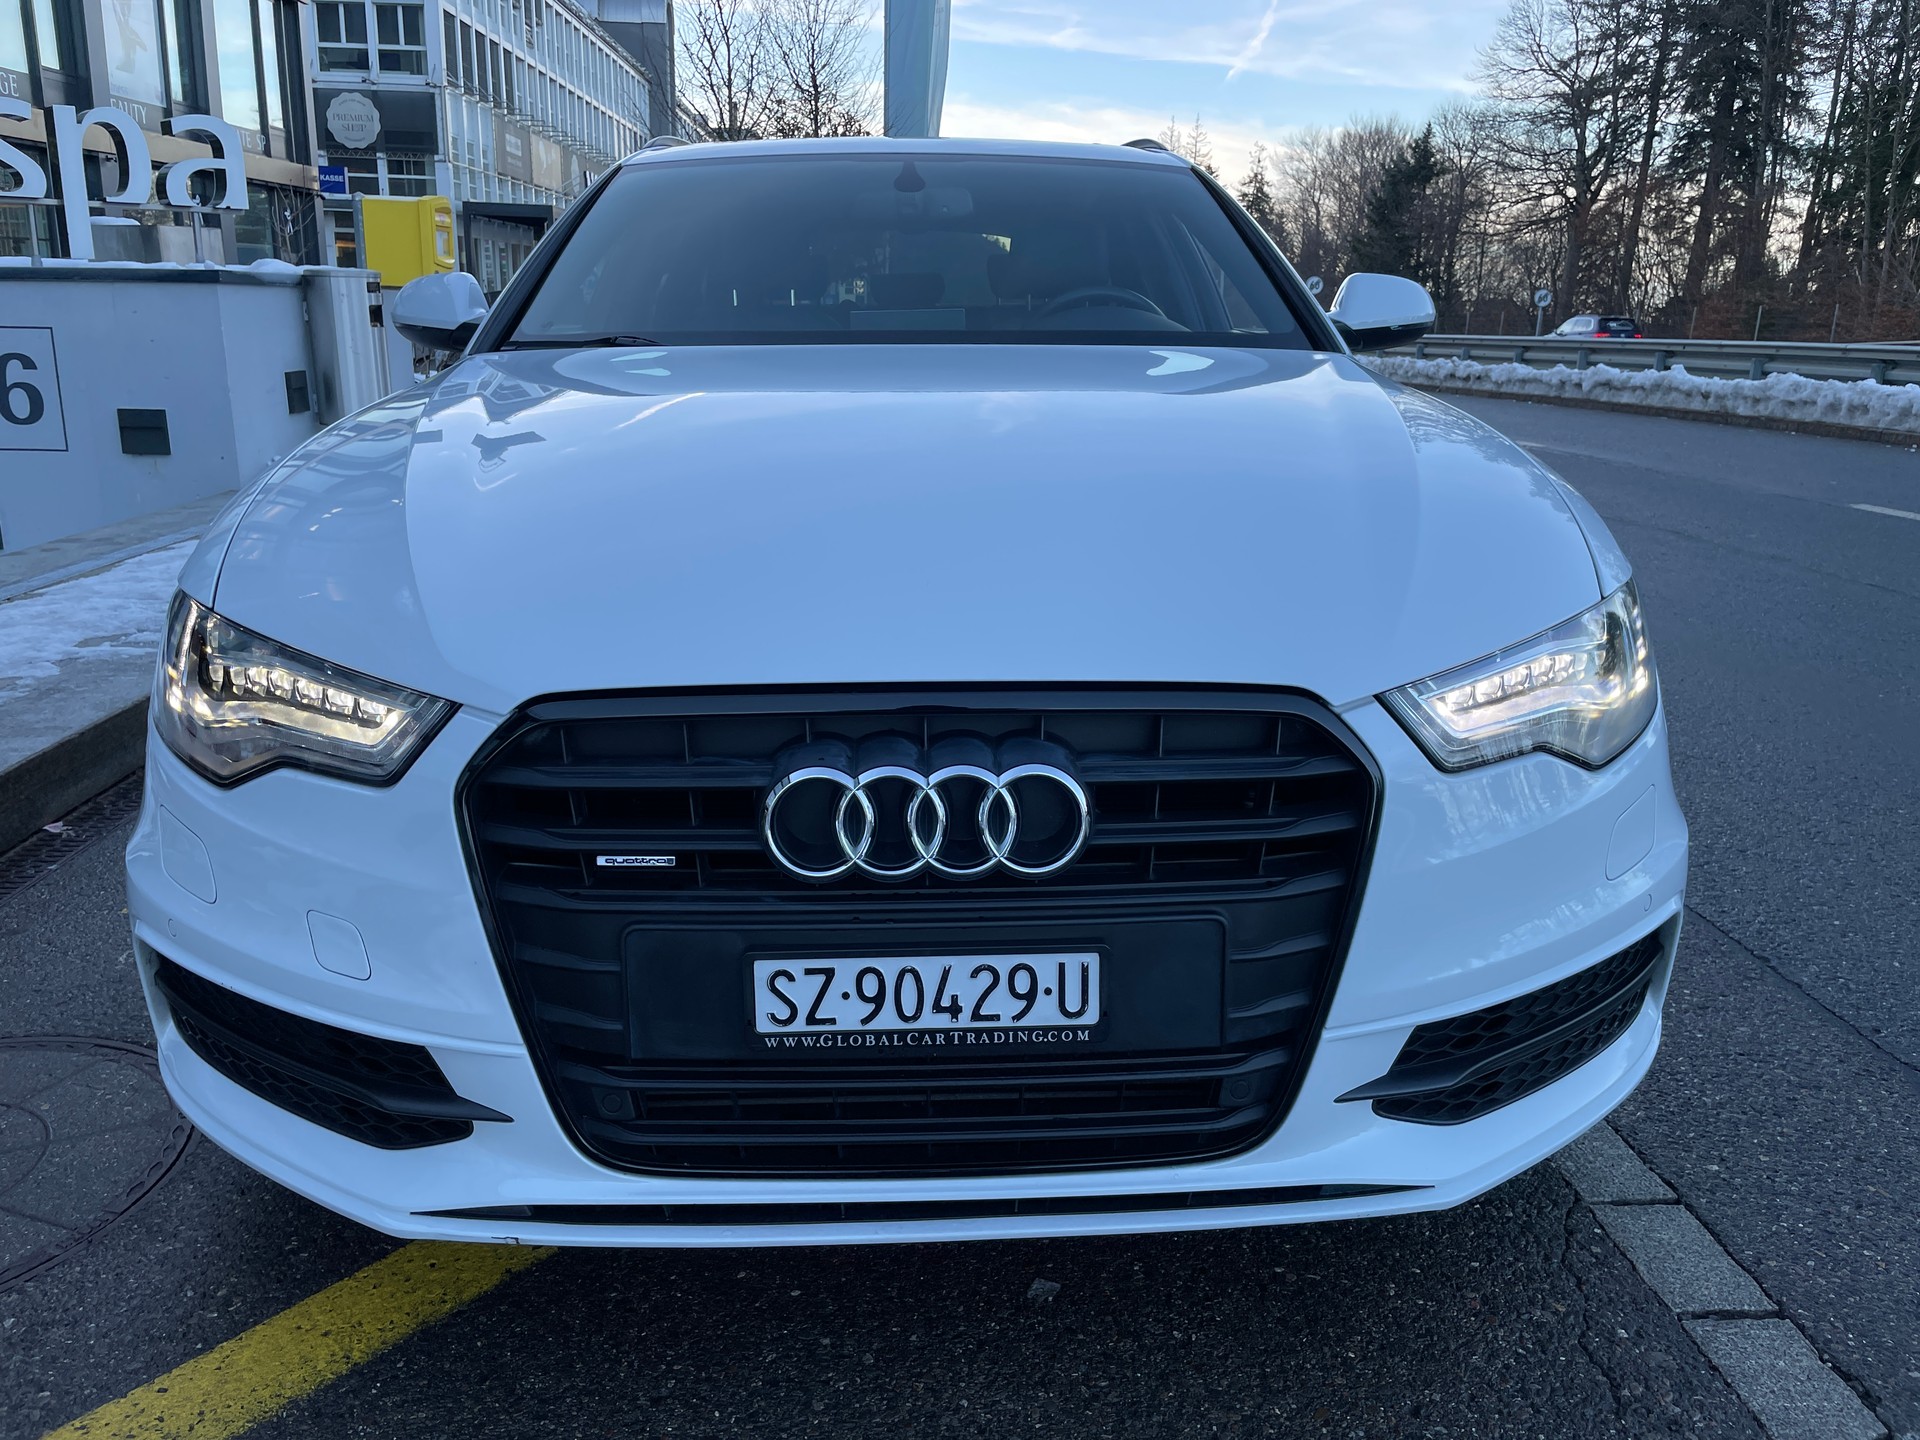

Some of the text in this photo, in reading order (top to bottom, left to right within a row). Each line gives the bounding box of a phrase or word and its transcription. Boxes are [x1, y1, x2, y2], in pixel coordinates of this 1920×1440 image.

[332, 113, 374, 122] PREMIUM
[320, 174, 344, 182] KASSE
[605, 858, 667, 866] quattro
